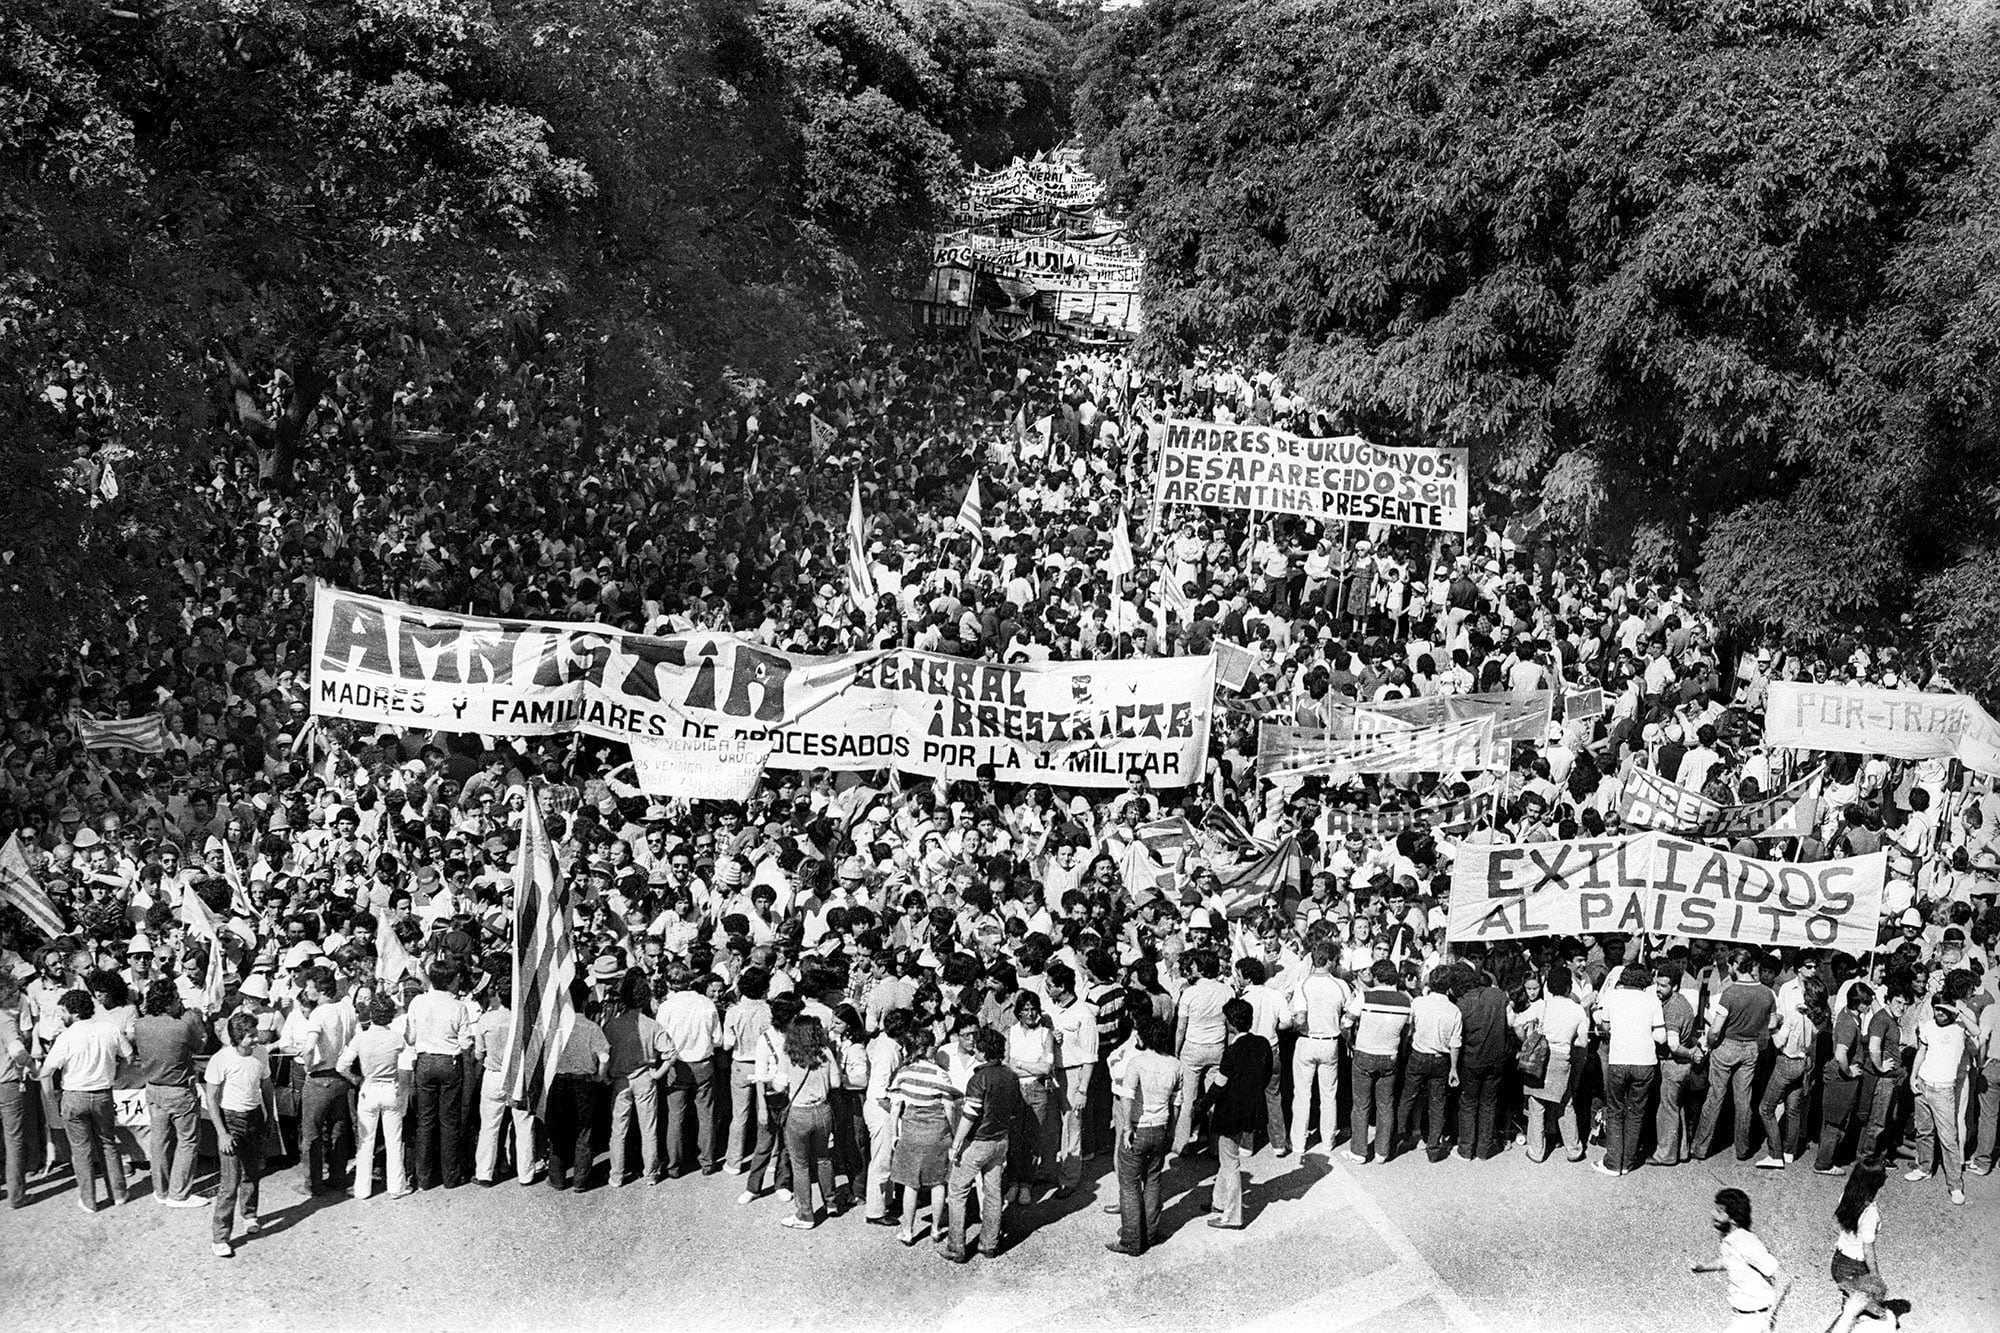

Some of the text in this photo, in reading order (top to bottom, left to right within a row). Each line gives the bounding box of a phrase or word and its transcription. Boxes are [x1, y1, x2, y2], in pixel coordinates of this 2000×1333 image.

[1167, 425, 1453, 478] MADRES DE URUGUAYOS
[1164, 480, 1442, 526] ARGENTINA PRESENTE
[320, 680, 426, 714] MADRES
[452, 696, 468, 719] Y
[491, 699, 668, 746] FAMILIARES
[682, 719, 719, 738] DE
[924, 741, 975, 768] POR
[989, 745, 1019, 769] LA
[1034, 749, 1056, 771] J.
[1068, 750, 1180, 775] MILITAR
[1486, 839, 1855, 916] EXILIADOS
[1477, 892, 1838, 946] AL PAISITO
